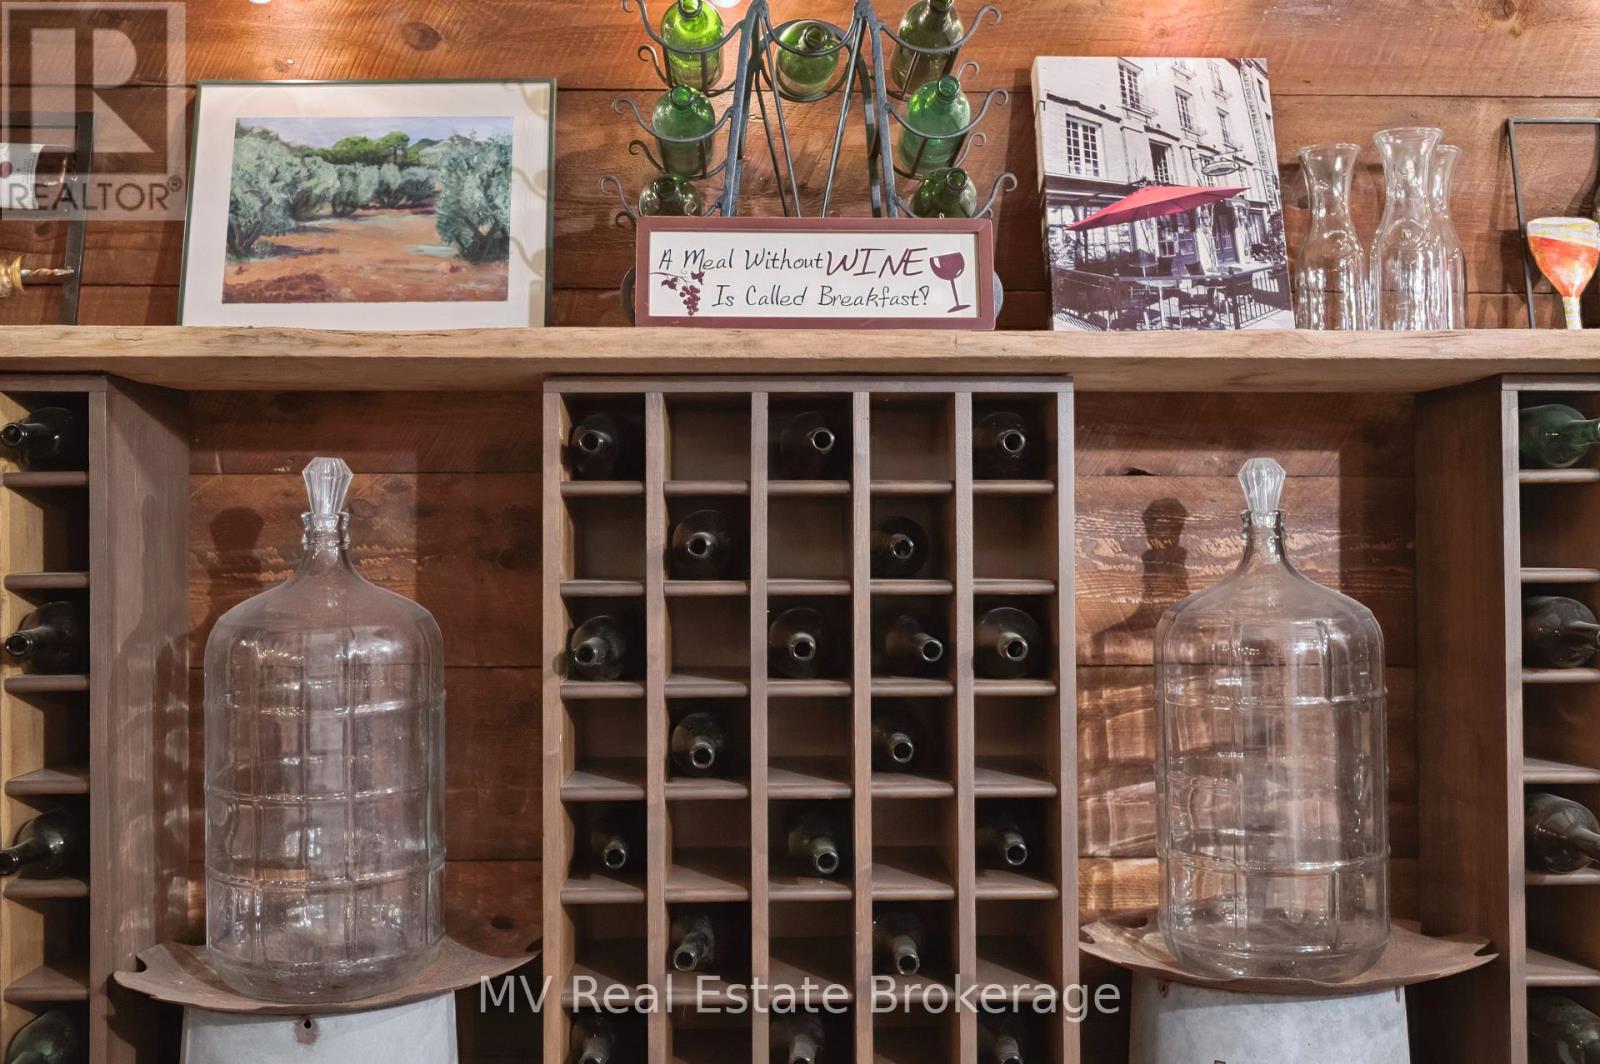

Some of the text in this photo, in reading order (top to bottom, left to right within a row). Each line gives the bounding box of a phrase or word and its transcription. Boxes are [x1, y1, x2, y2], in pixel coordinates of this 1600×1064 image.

[658, 247, 928, 278] A Meal Without WINE
[711, 284, 930, 308] Is Called Breakfast?
